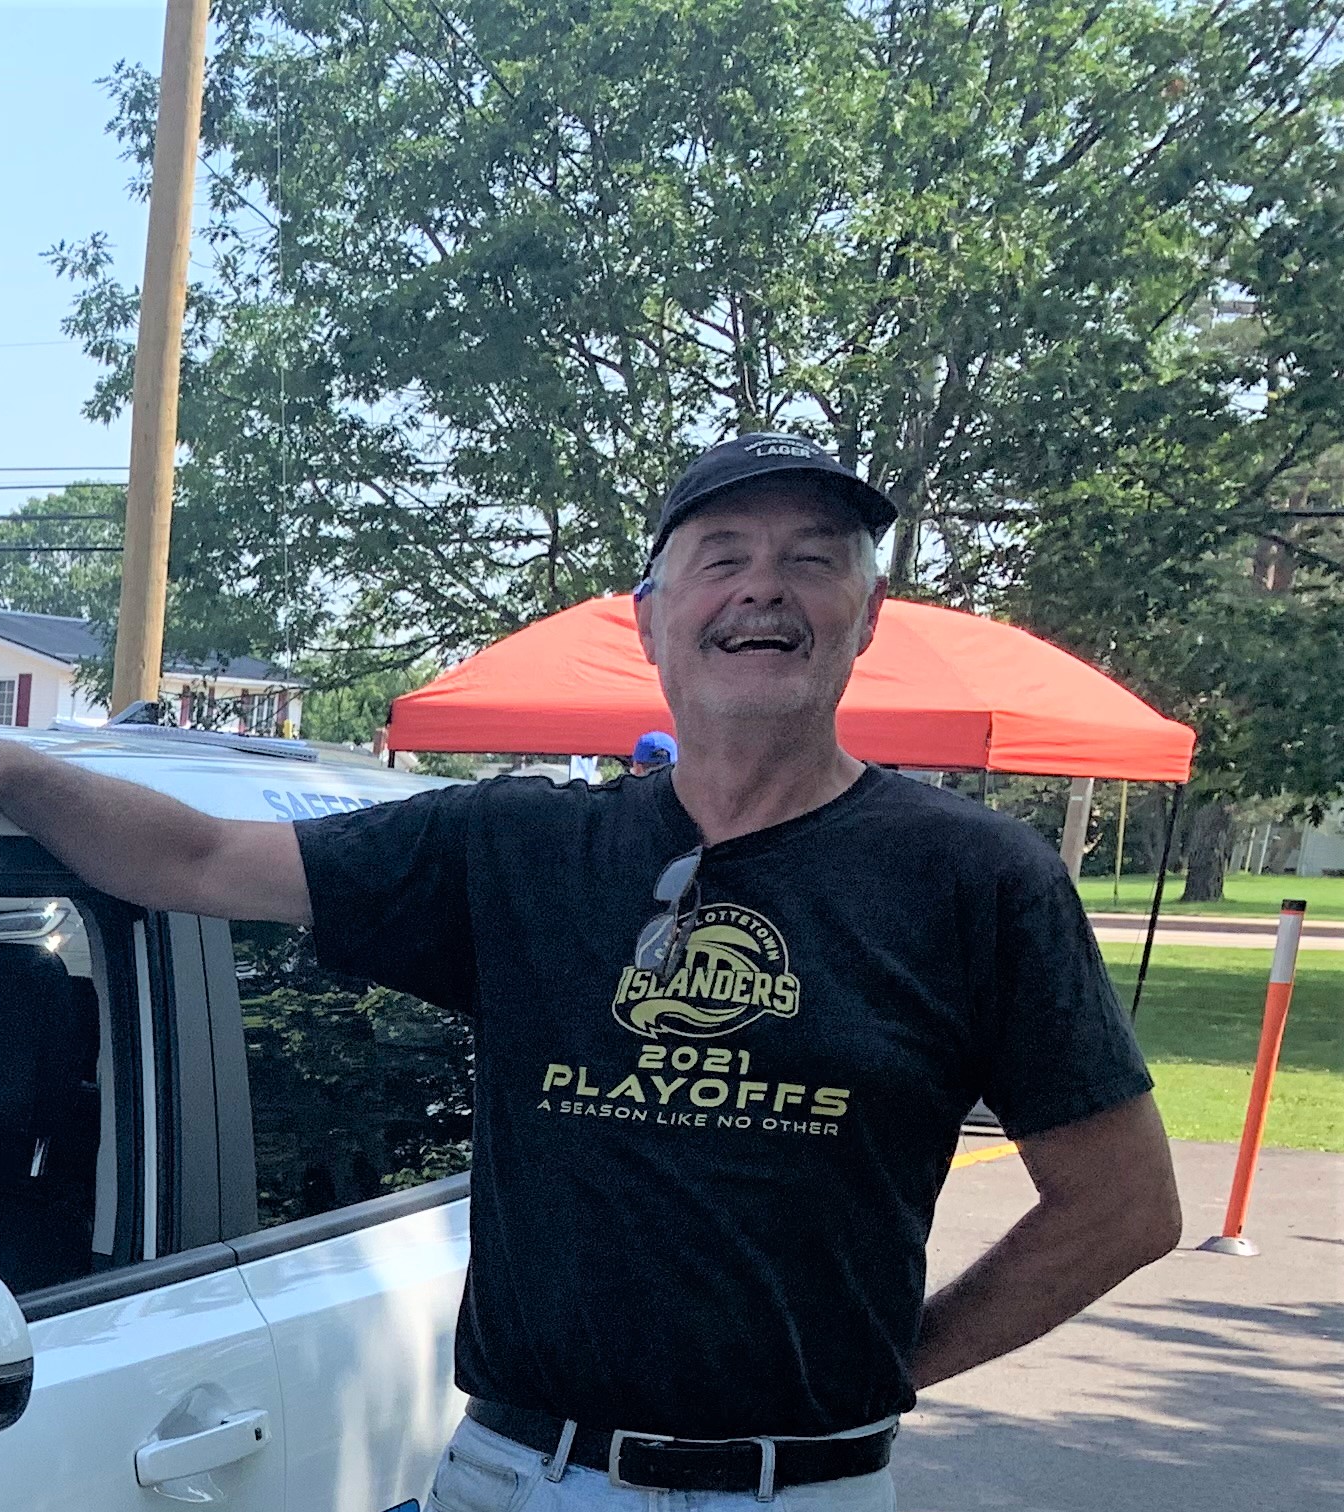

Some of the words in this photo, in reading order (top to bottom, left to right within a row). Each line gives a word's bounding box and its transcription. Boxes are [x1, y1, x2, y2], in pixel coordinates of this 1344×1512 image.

[756, 445, 811, 459] LAGER
[616, 966, 797, 1012] ISLANDERS
[637, 1044, 751, 1075] 2021
[542, 1063, 851, 1118] PLAYOFFS
[537, 1099, 551, 1112] A
[560, 1100, 648, 1122] SEASON
[656, 1111, 708, 1128] LIKE
[717, 1114, 752, 1130] NO
[762, 1117, 839, 1137] OTHER
